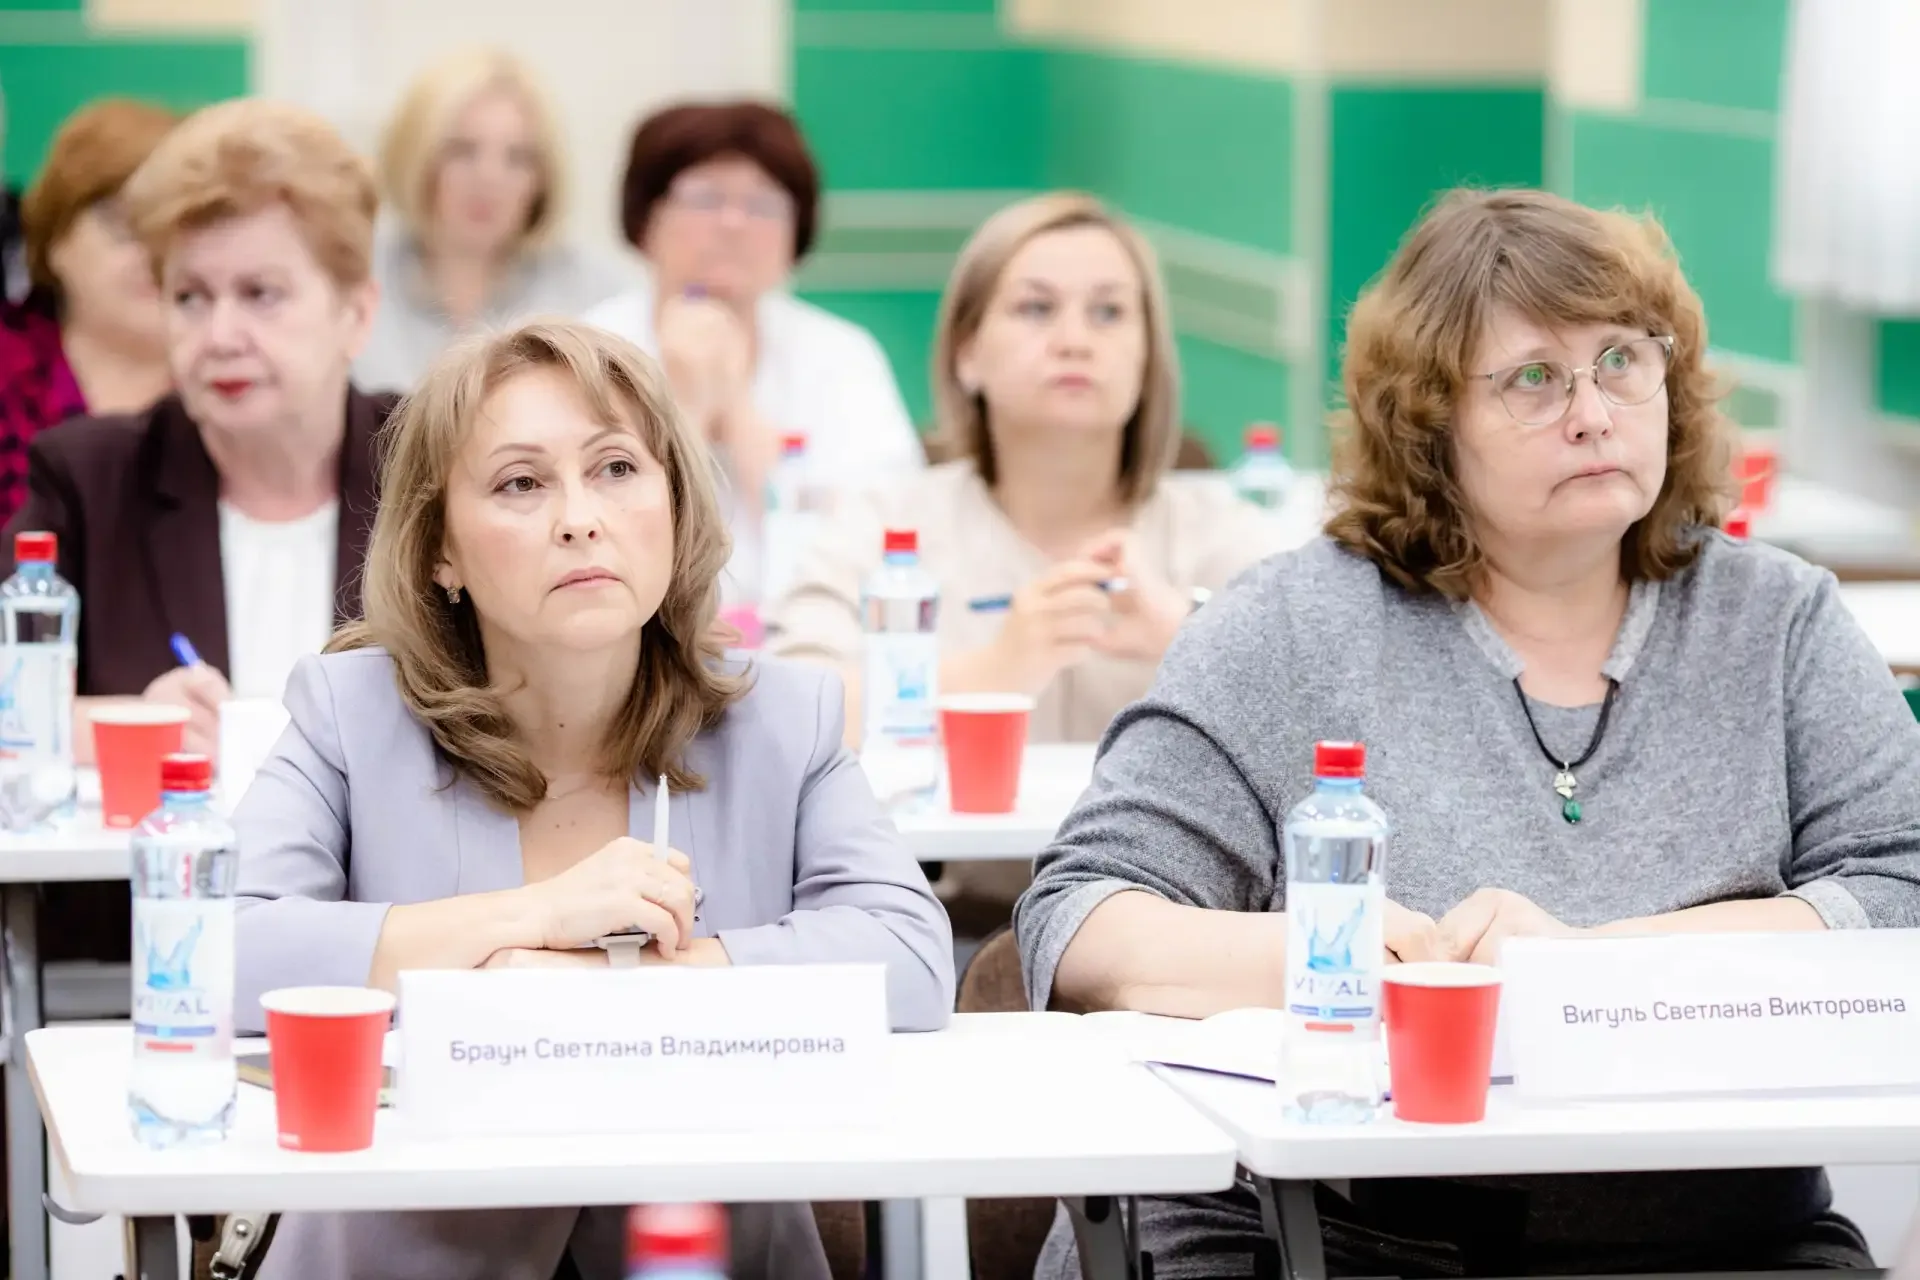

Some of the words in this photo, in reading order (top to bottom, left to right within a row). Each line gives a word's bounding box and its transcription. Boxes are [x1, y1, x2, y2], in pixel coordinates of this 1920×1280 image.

[1562, 1004, 1648, 1029] Вигуль
[1652, 1001, 1763, 1021] Светлана
[1768, 996, 1907, 1021] Викторовна
[450, 1039, 527, 1066] Браун
[534, 1038, 653, 1059] Светлана
[660, 1035, 845, 1059] Владимировна
